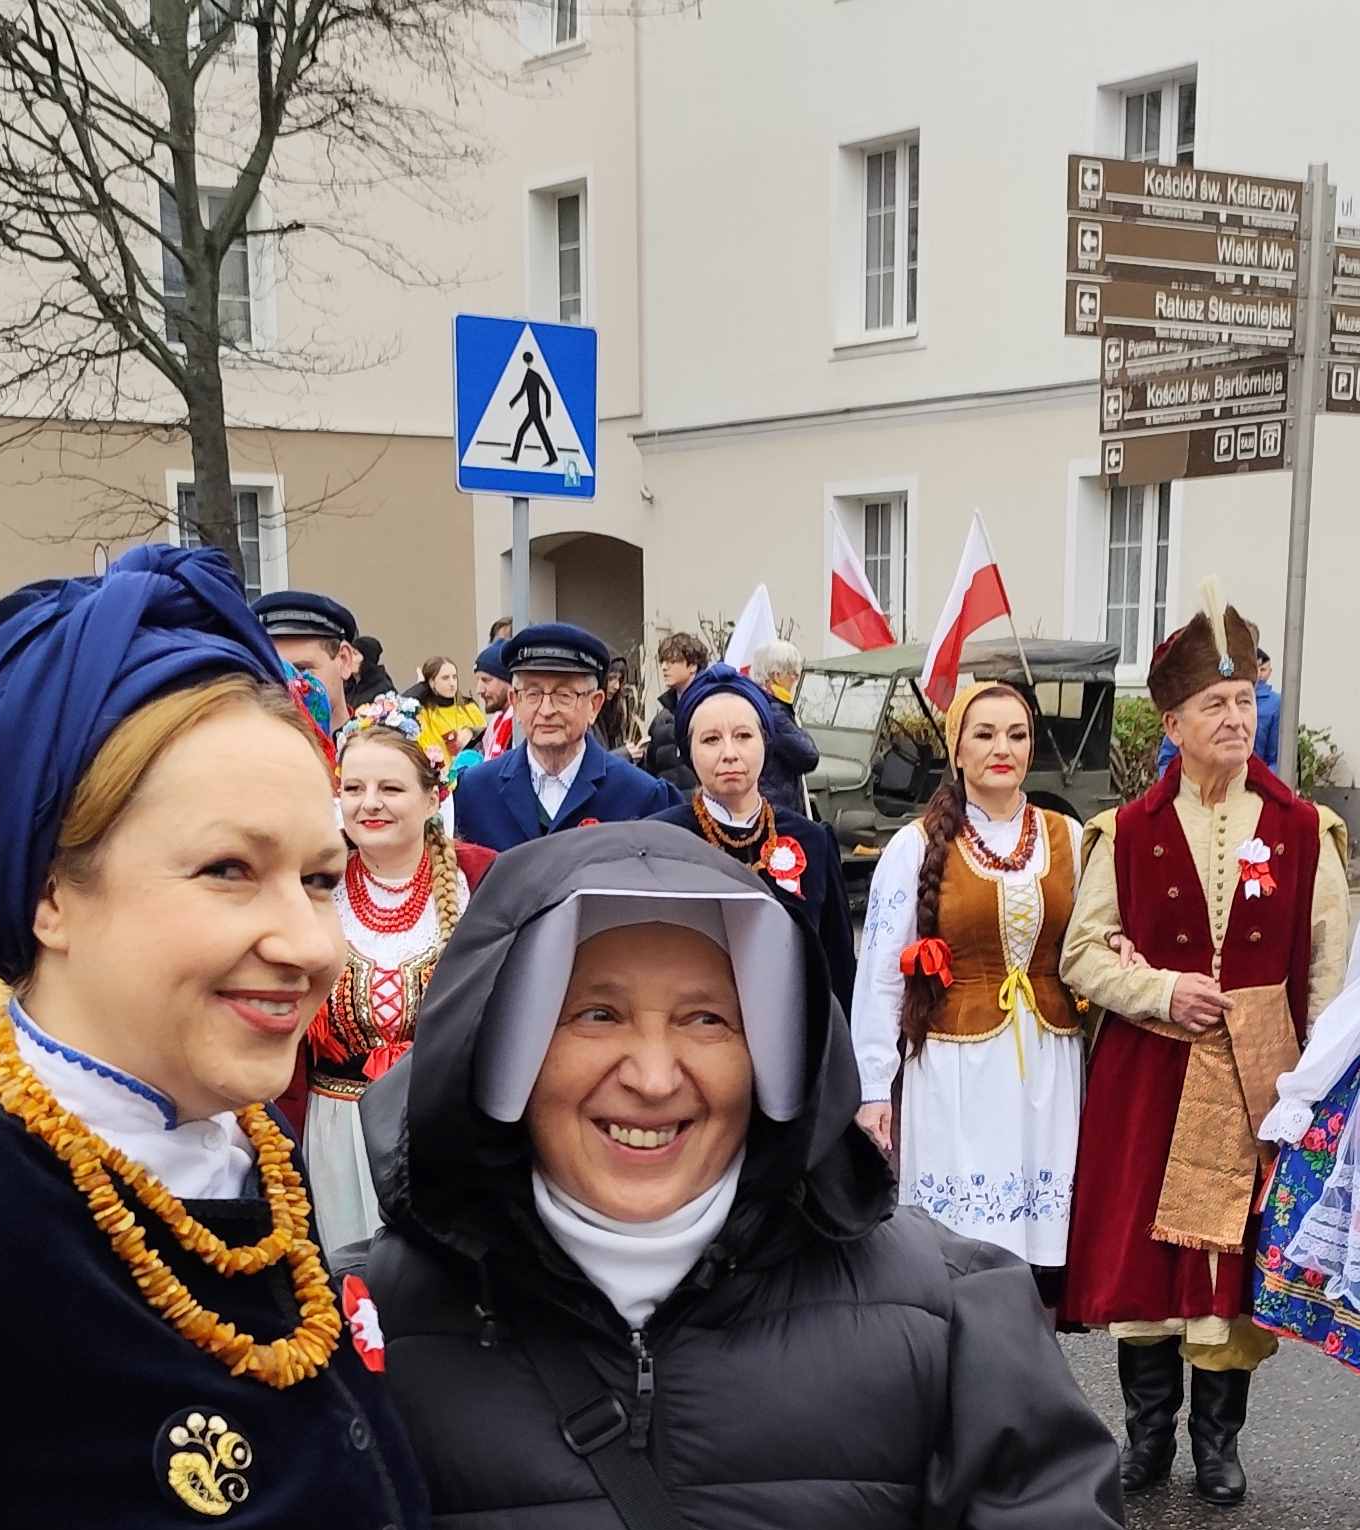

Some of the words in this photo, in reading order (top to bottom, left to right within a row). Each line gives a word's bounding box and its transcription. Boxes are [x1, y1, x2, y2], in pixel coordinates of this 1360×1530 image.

[1144, 167, 1196, 200] Kościół
[1200, 174, 1223, 202] św.
[1227, 177, 1296, 214] Katarzyny
[1217, 236, 1258, 264] Wielki
[1262, 241, 1294, 272] Młyn
[1155, 291, 1204, 321] Ratusz
[1208, 296, 1291, 330] Staromiejski
[1146, 380, 1189, 408] Kościół
[1192, 380, 1211, 402] św.
[1214, 368, 1283, 399] Bartłomieja
